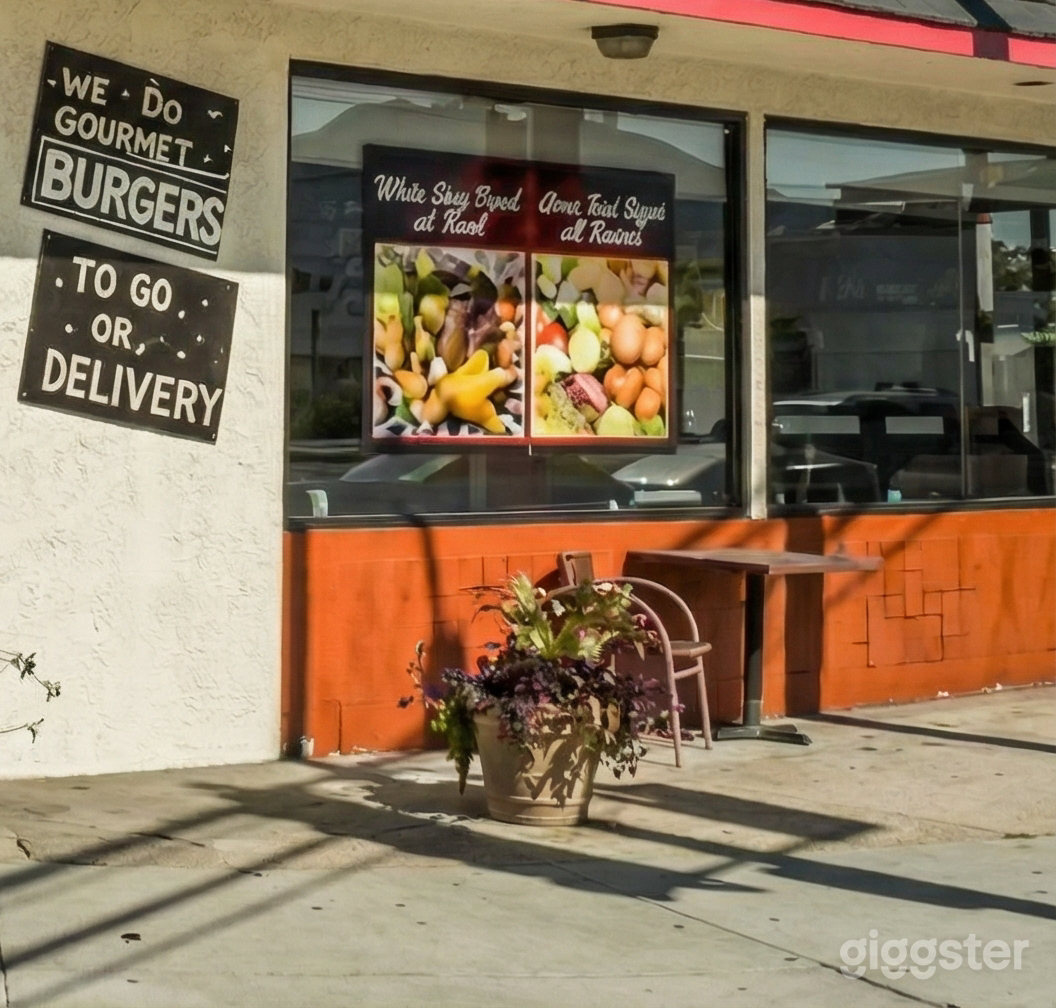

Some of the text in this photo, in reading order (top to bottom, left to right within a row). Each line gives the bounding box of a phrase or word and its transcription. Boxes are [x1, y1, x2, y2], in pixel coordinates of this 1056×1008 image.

[62, 66, 110, 106] WE
[54, 105, 194, 167] GOURMET
[40, 148, 225, 246] BURGERS
[72, 256, 173, 312] TO GO
[41, 347, 223, 427] DELIVERY
